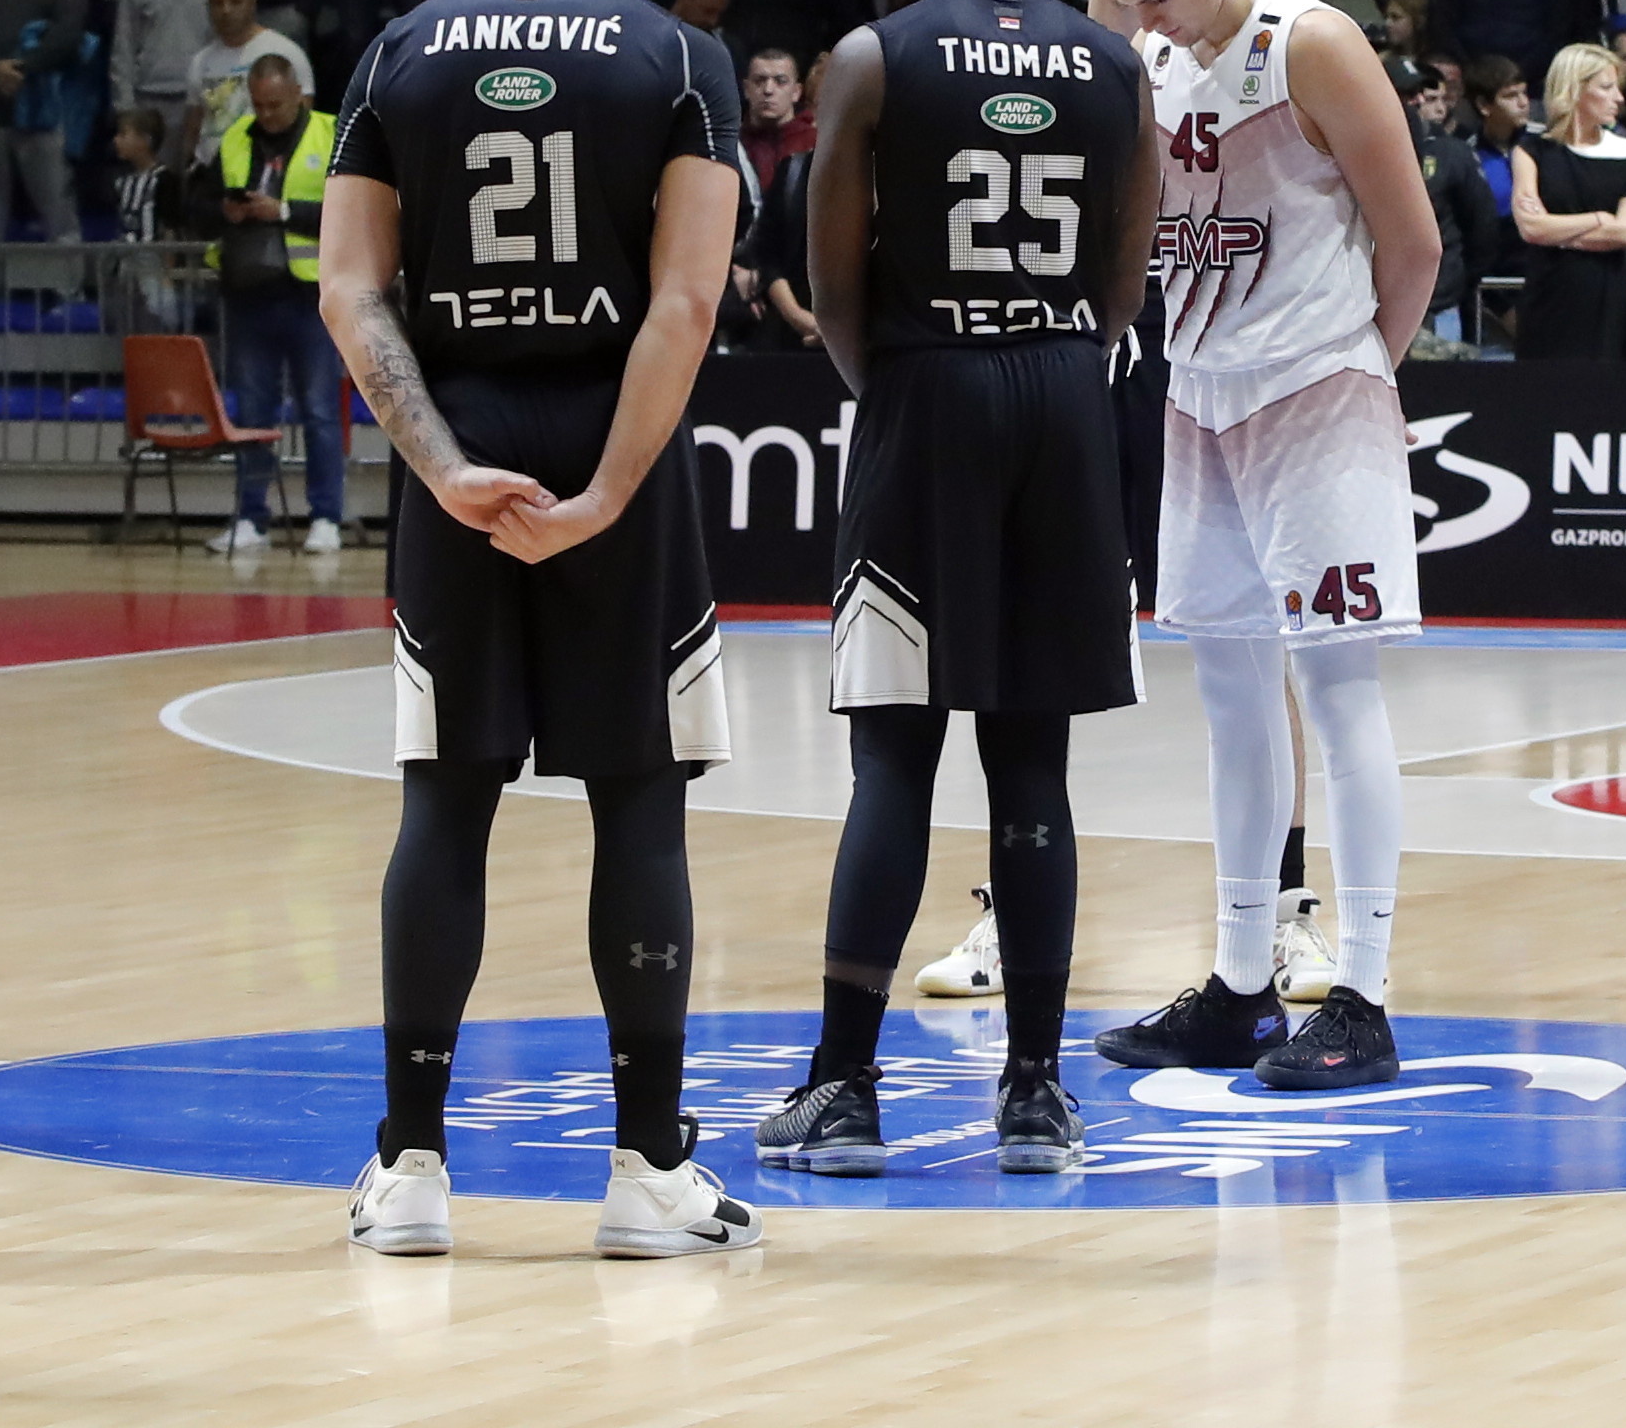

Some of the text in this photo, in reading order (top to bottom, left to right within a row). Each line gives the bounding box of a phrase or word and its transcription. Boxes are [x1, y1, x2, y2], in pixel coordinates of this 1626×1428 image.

[422, 14, 623, 57] JANKOVIĆ
[937, 36, 1094, 82] THOMAS
[1169, 112, 1219, 173] 45
[464, 130, 578, 264] 21
[946, 149, 1085, 276] 25
[429, 286, 621, 329] TESLA
[930, 298, 1097, 335] TESLA
[1311, 562, 1383, 626] 45
